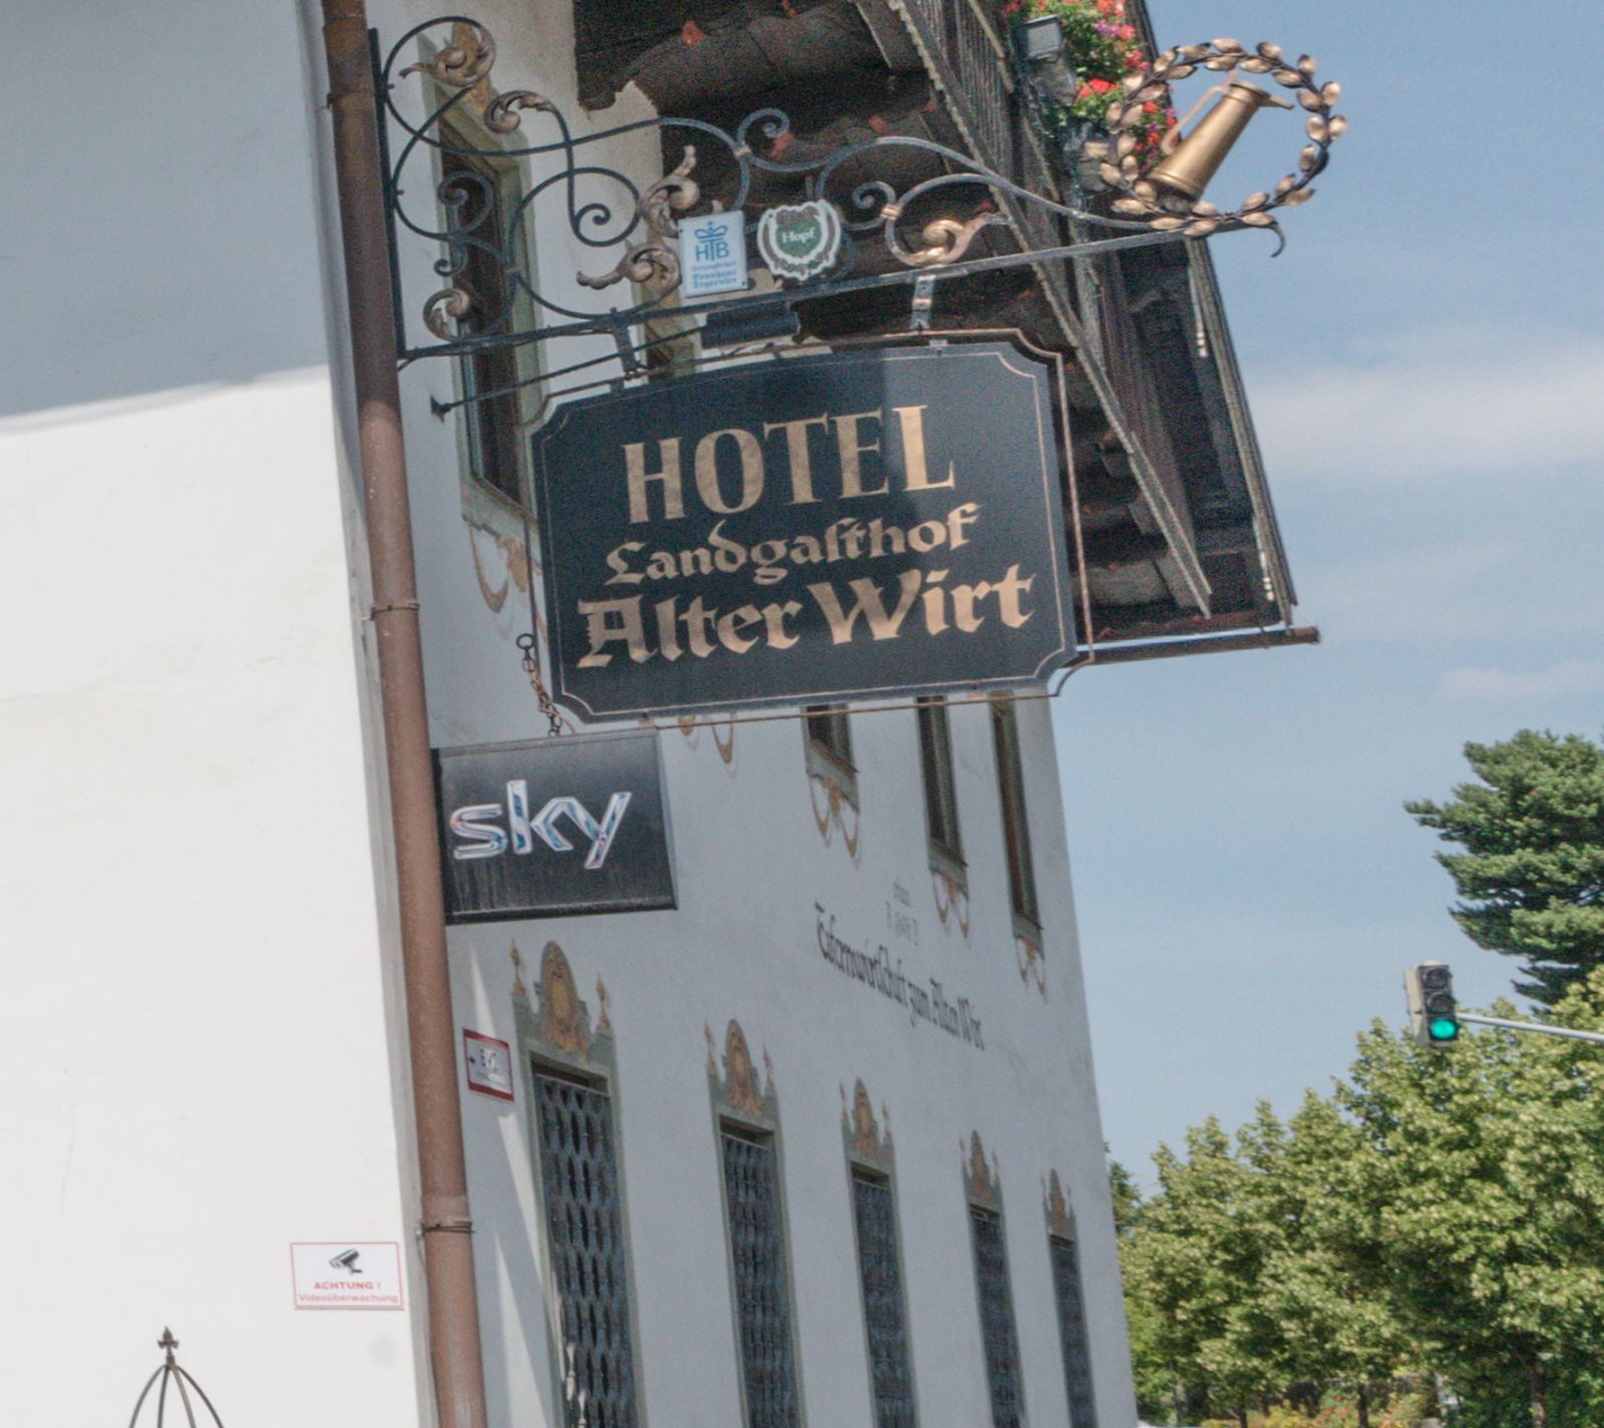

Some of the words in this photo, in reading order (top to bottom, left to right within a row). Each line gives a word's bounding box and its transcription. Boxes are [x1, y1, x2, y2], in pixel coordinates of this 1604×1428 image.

[782, 227, 817, 244] Hopf
[694, 239, 731, 262] HTB
[623, 404, 956, 524] HOTEL
[577, 593, 804, 669] Alter
[807, 563, 1038, 646] Wirt
[449, 779, 632, 870] sky
[313, 1281, 374, 1290] ACHTUNG
[298, 1294, 399, 1304] Videoüberwachung
